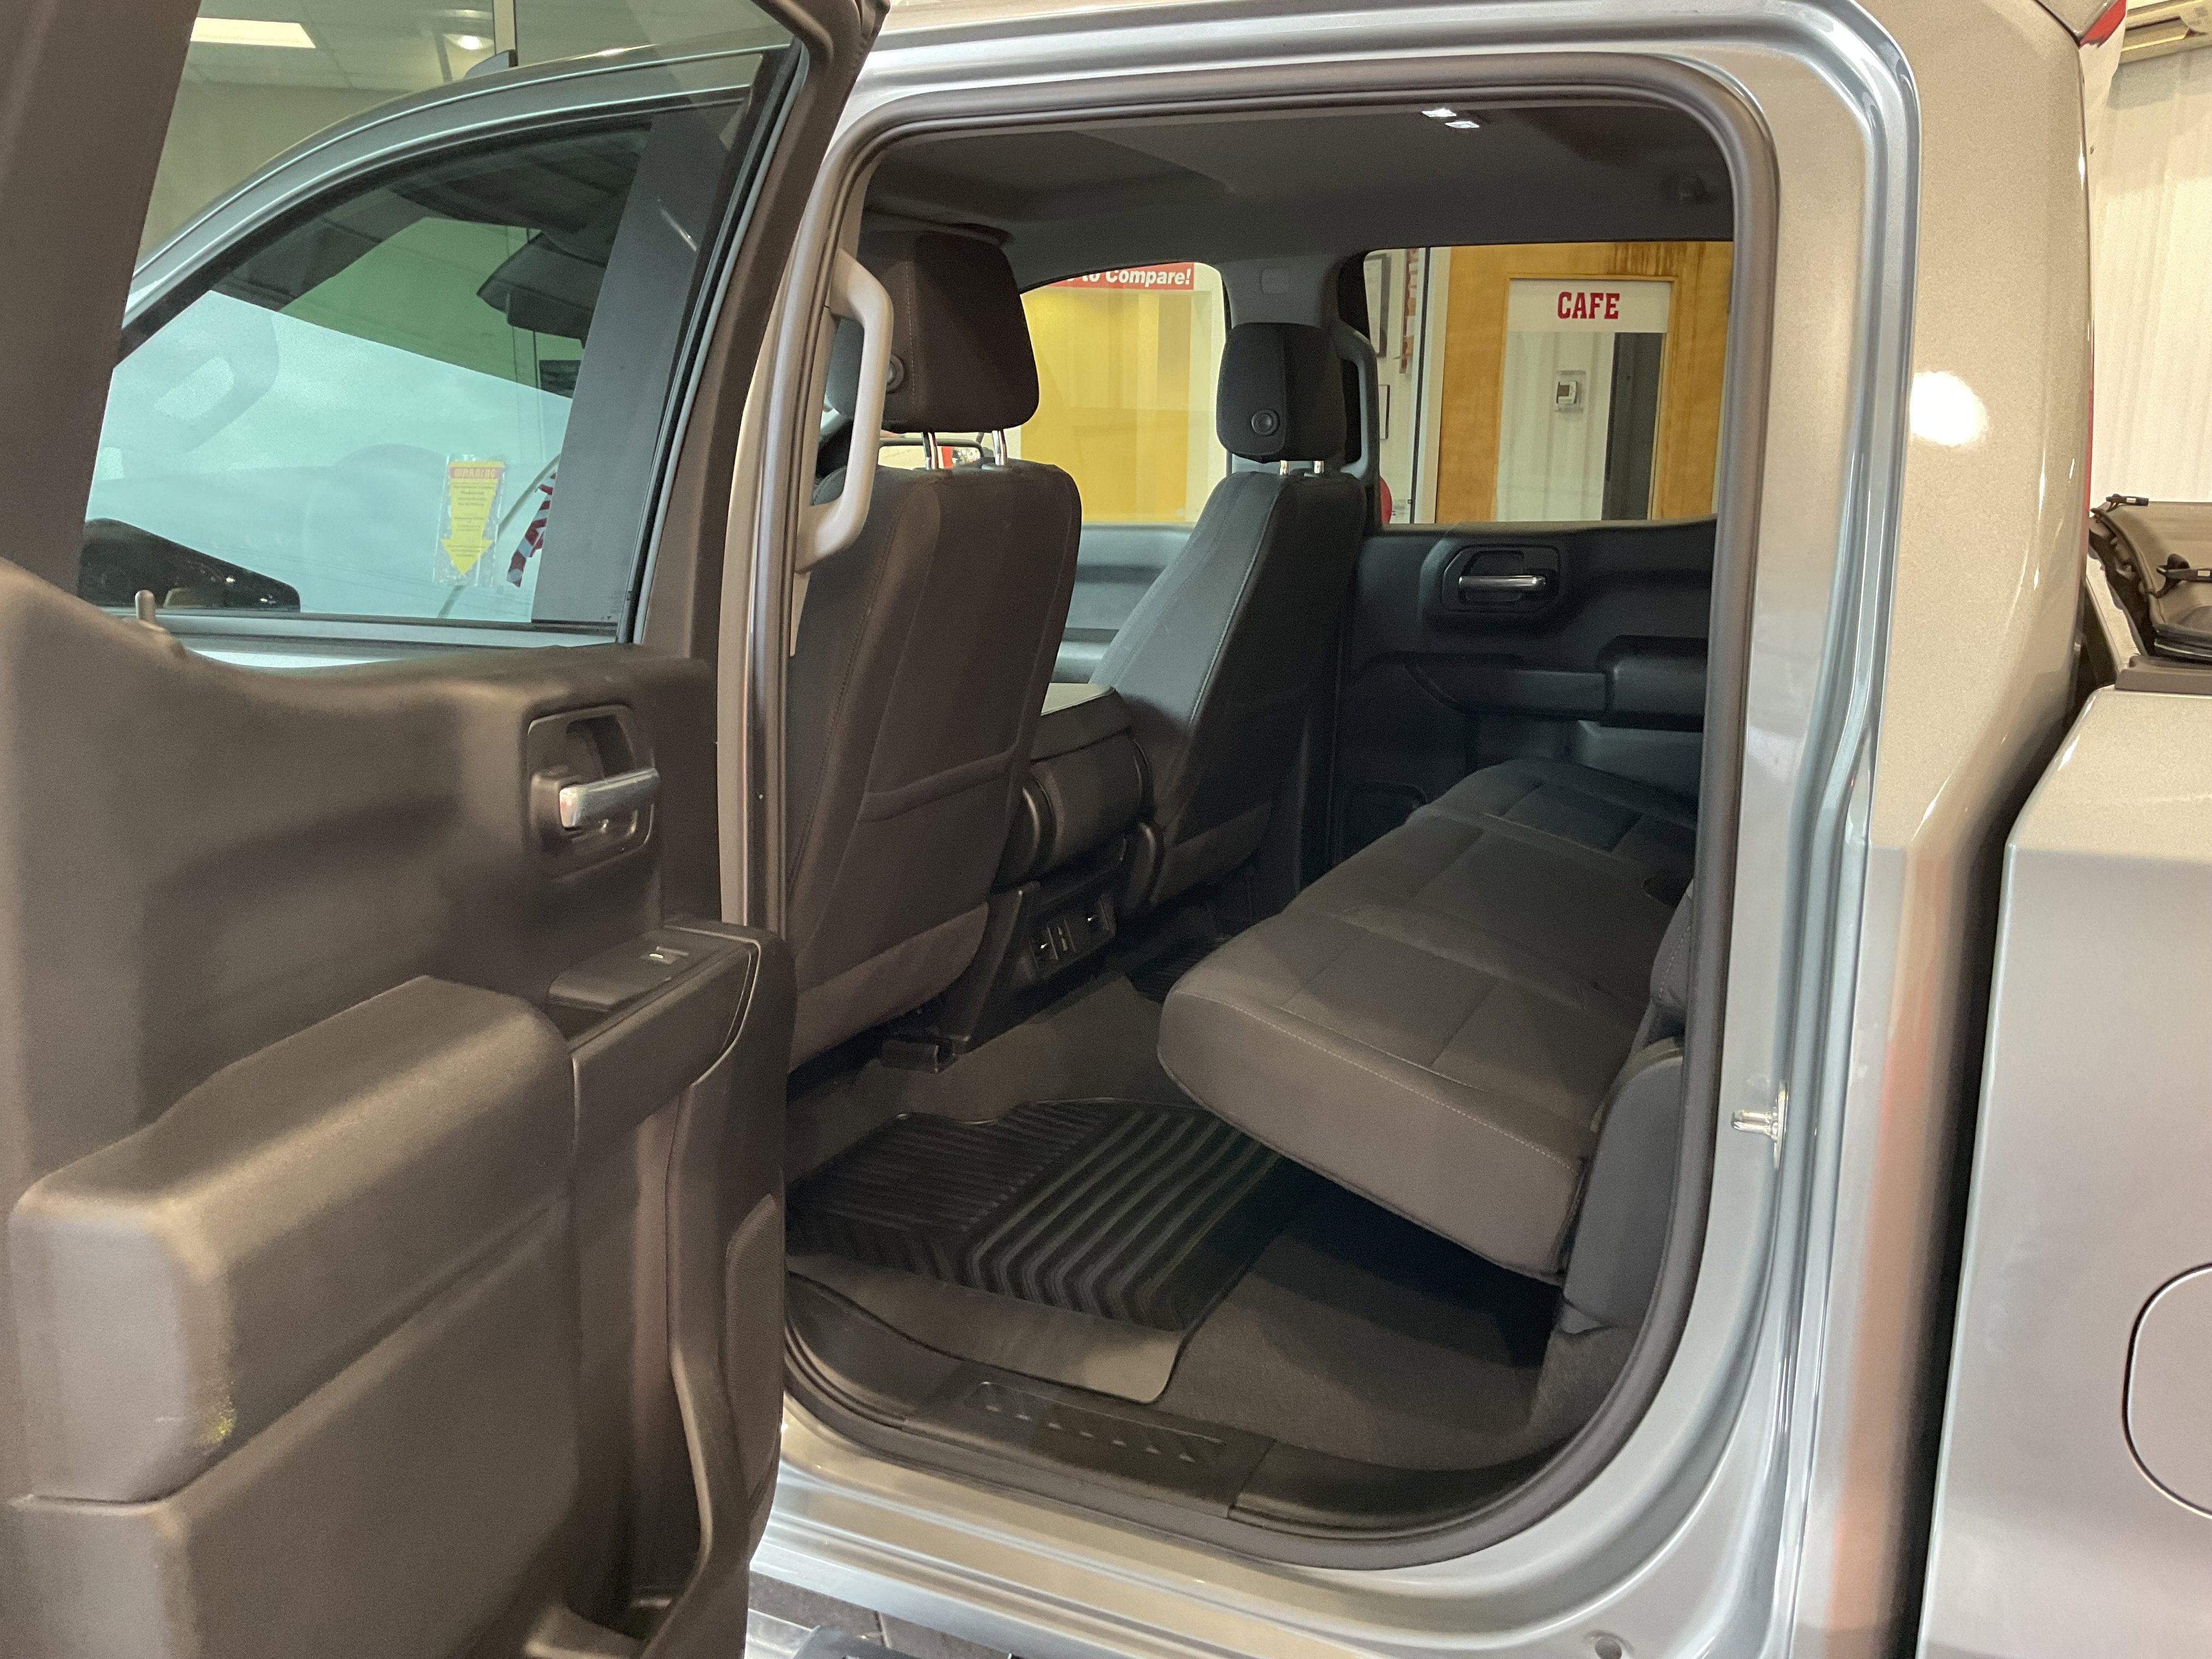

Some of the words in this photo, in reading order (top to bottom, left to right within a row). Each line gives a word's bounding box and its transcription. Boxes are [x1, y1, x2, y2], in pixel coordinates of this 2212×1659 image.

[1105, 268, 1192, 287] Compare!
[1558, 291, 1620, 319] CAFE
[454, 468, 496, 478] WARNING
